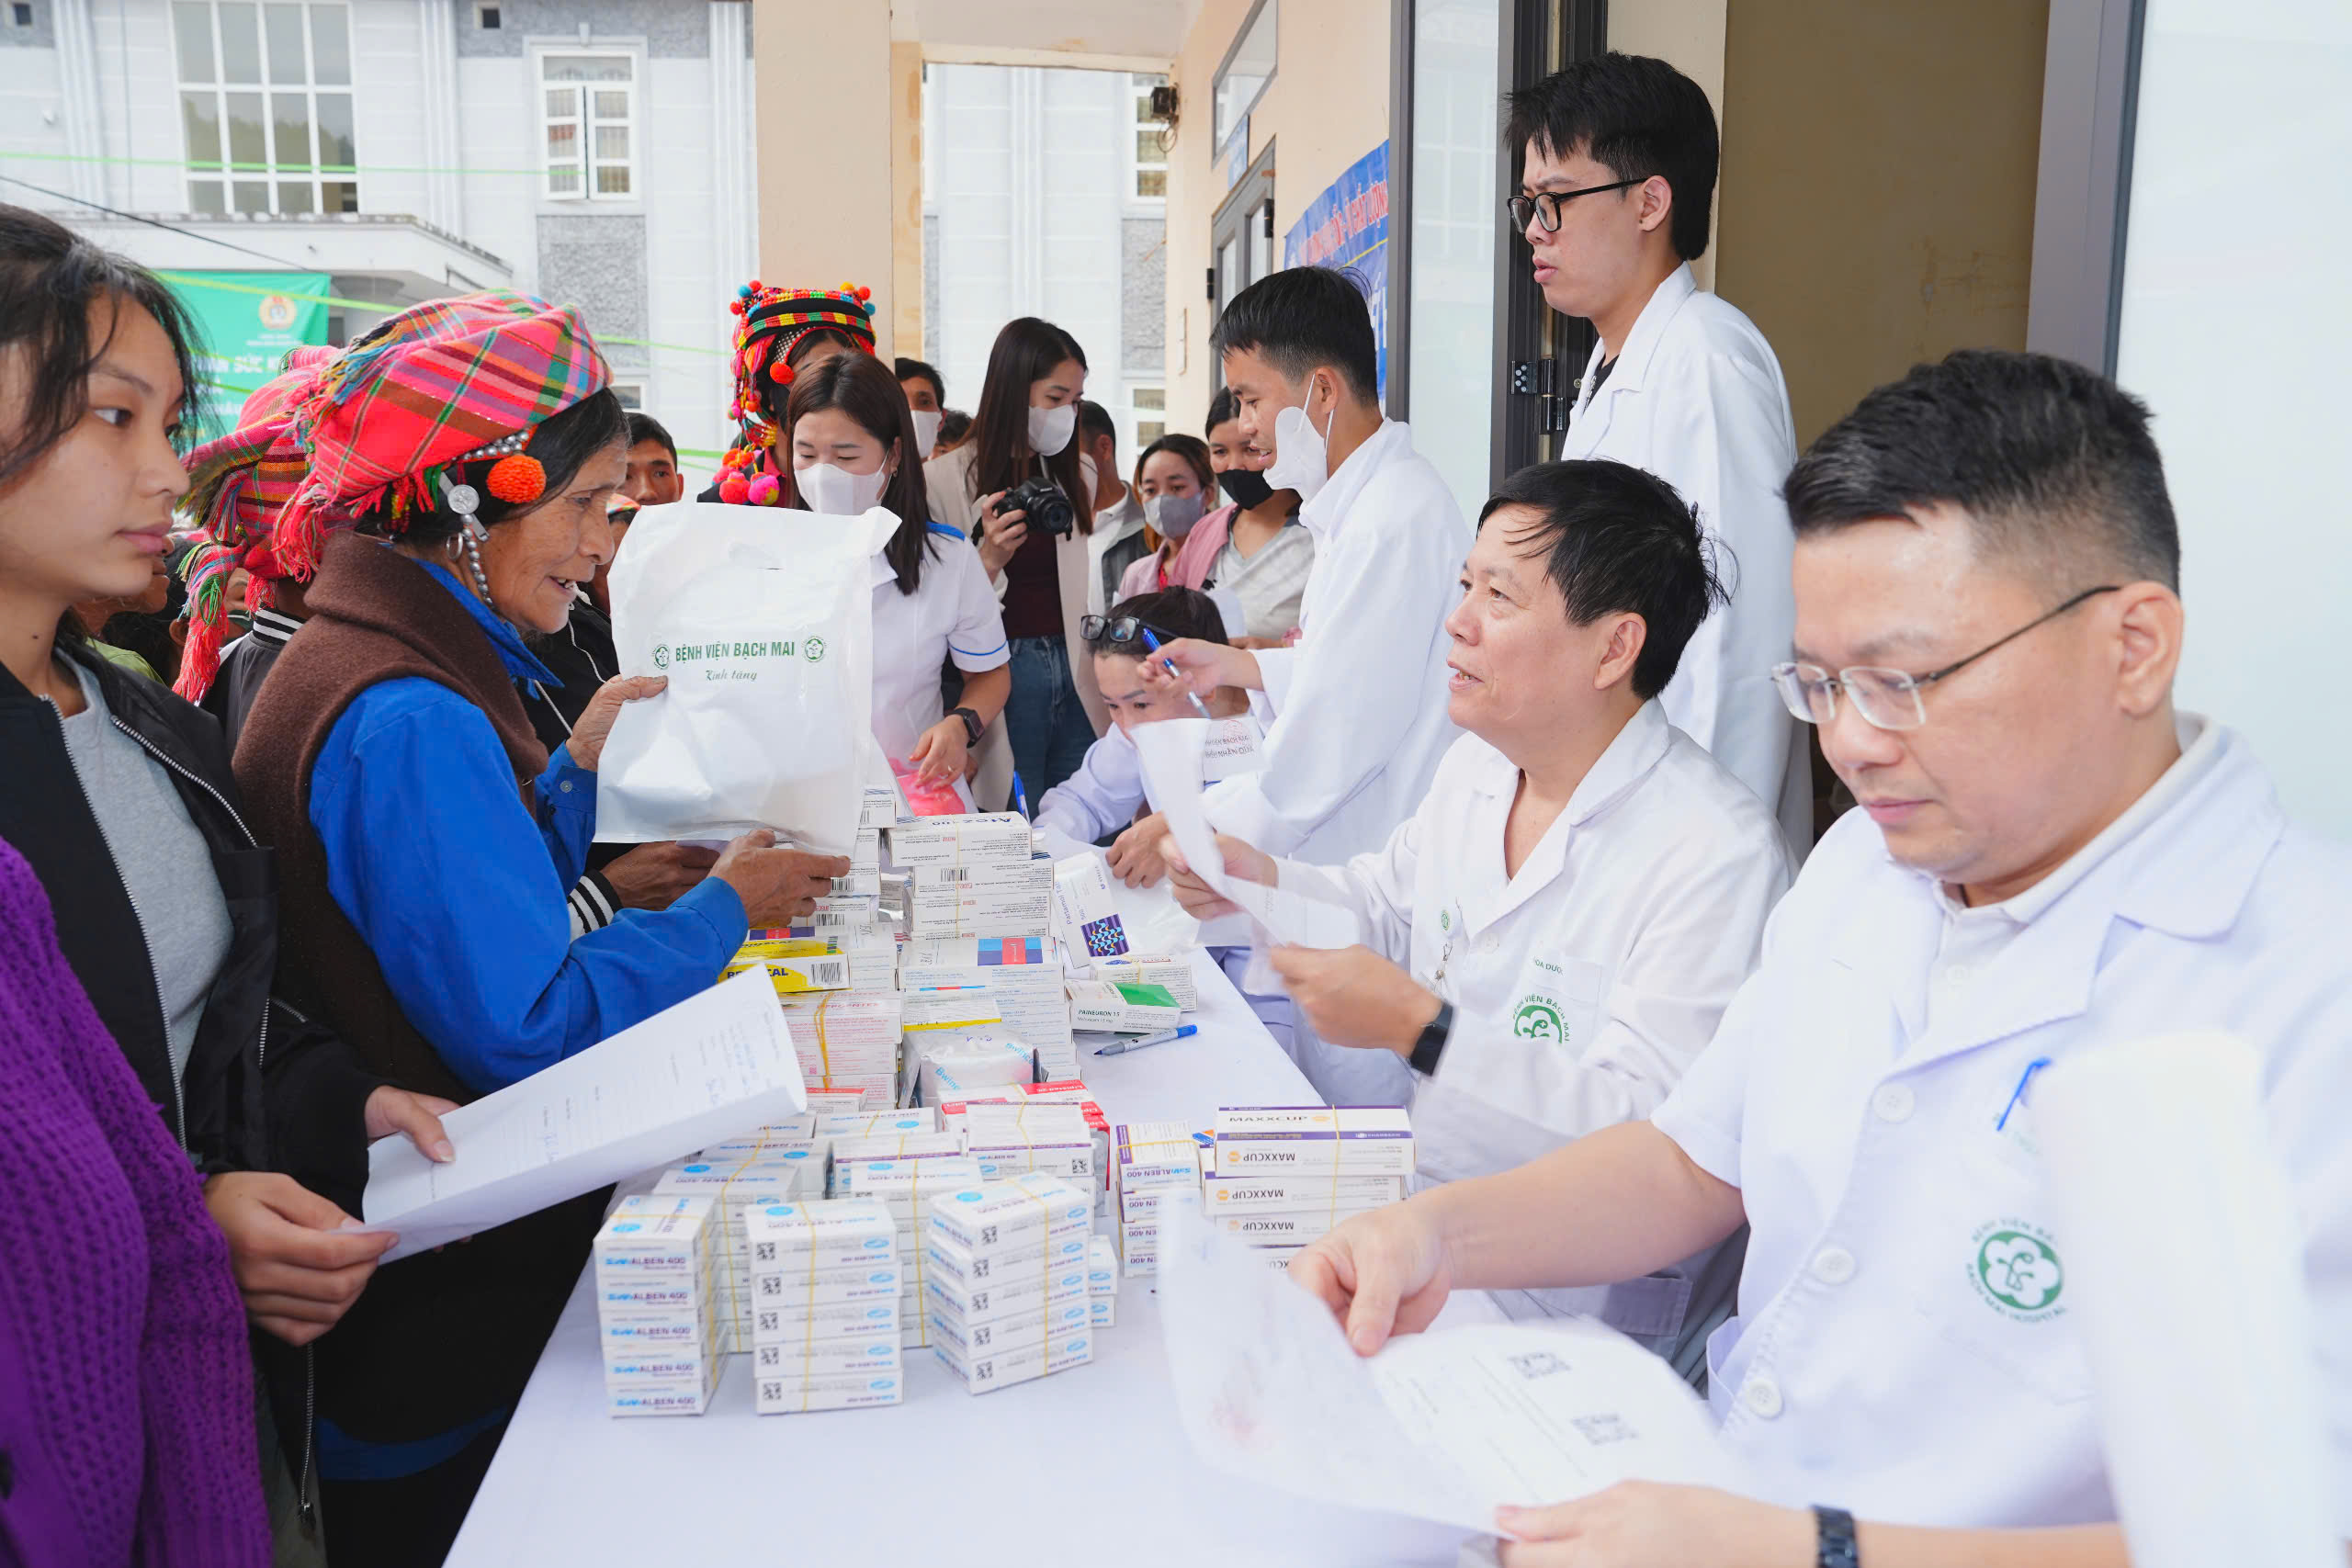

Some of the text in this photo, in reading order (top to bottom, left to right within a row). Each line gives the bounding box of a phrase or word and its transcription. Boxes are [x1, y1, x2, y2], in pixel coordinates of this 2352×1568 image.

[675, 643, 702, 664] BỆNH
[706, 640, 729, 661] VIỆN
[734, 642, 767, 660] BẠCH
[771, 641, 795, 657] MAI
[1058, 895, 1073, 925] Partamol
[1525, 993, 1544, 1003] VIỆN
[1546, 998, 1566, 1020] BẠCH
[1243, 1153, 1295, 1162] MAXXCUP
[1232, 1189, 1284, 1200] MAXXCUP
[1242, 1221, 1295, 1231] MAXXCUP
